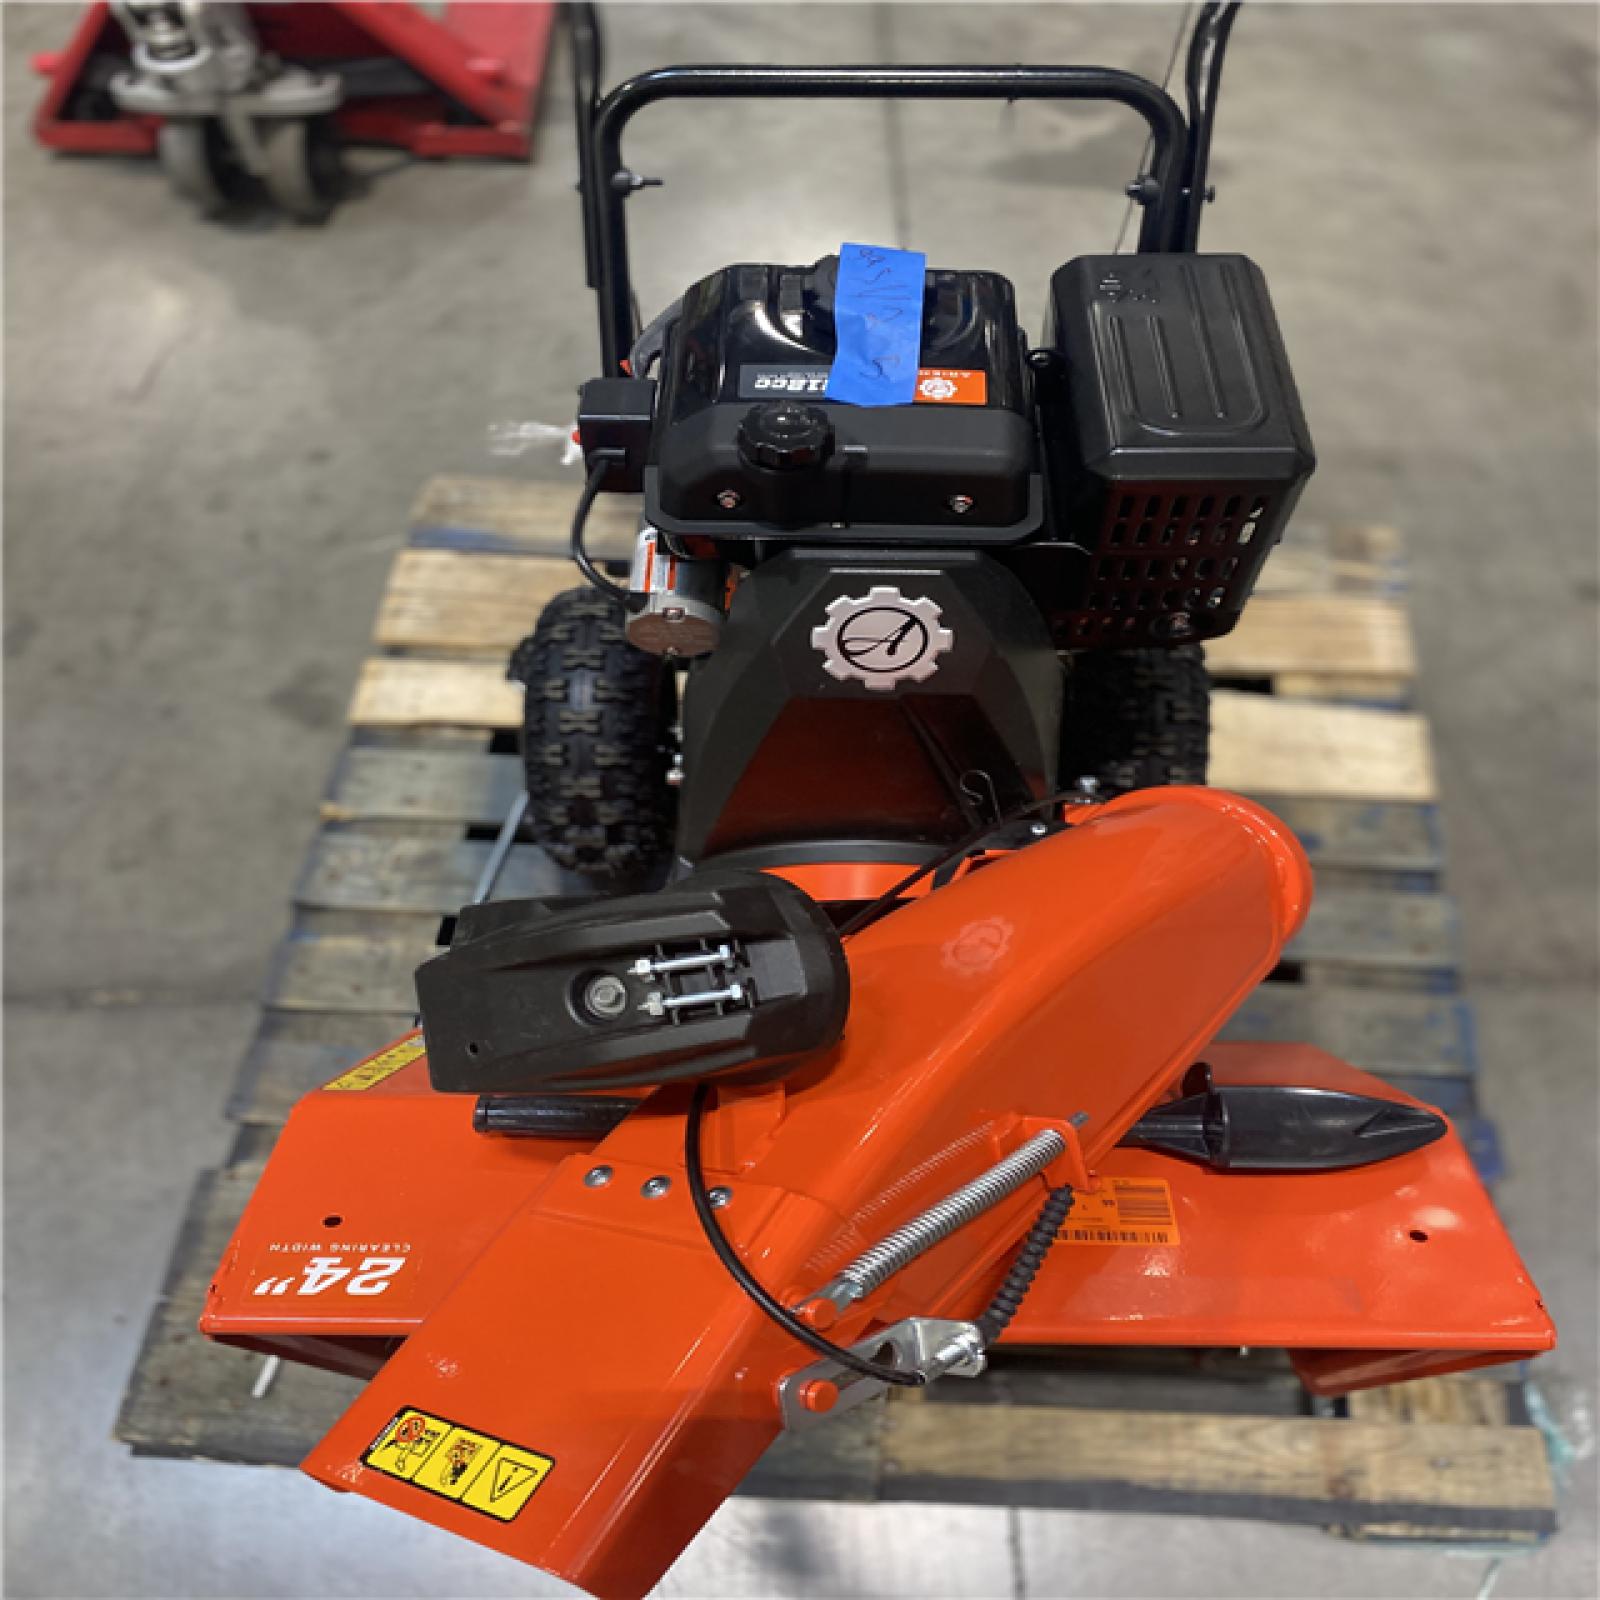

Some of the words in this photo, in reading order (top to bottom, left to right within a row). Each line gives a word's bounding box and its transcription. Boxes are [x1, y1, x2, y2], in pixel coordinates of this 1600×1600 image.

[918, 369, 972, 378] ARIEN
[270, 1242, 321, 1253] WIDTH
[330, 1242, 411, 1254] CLEARING
